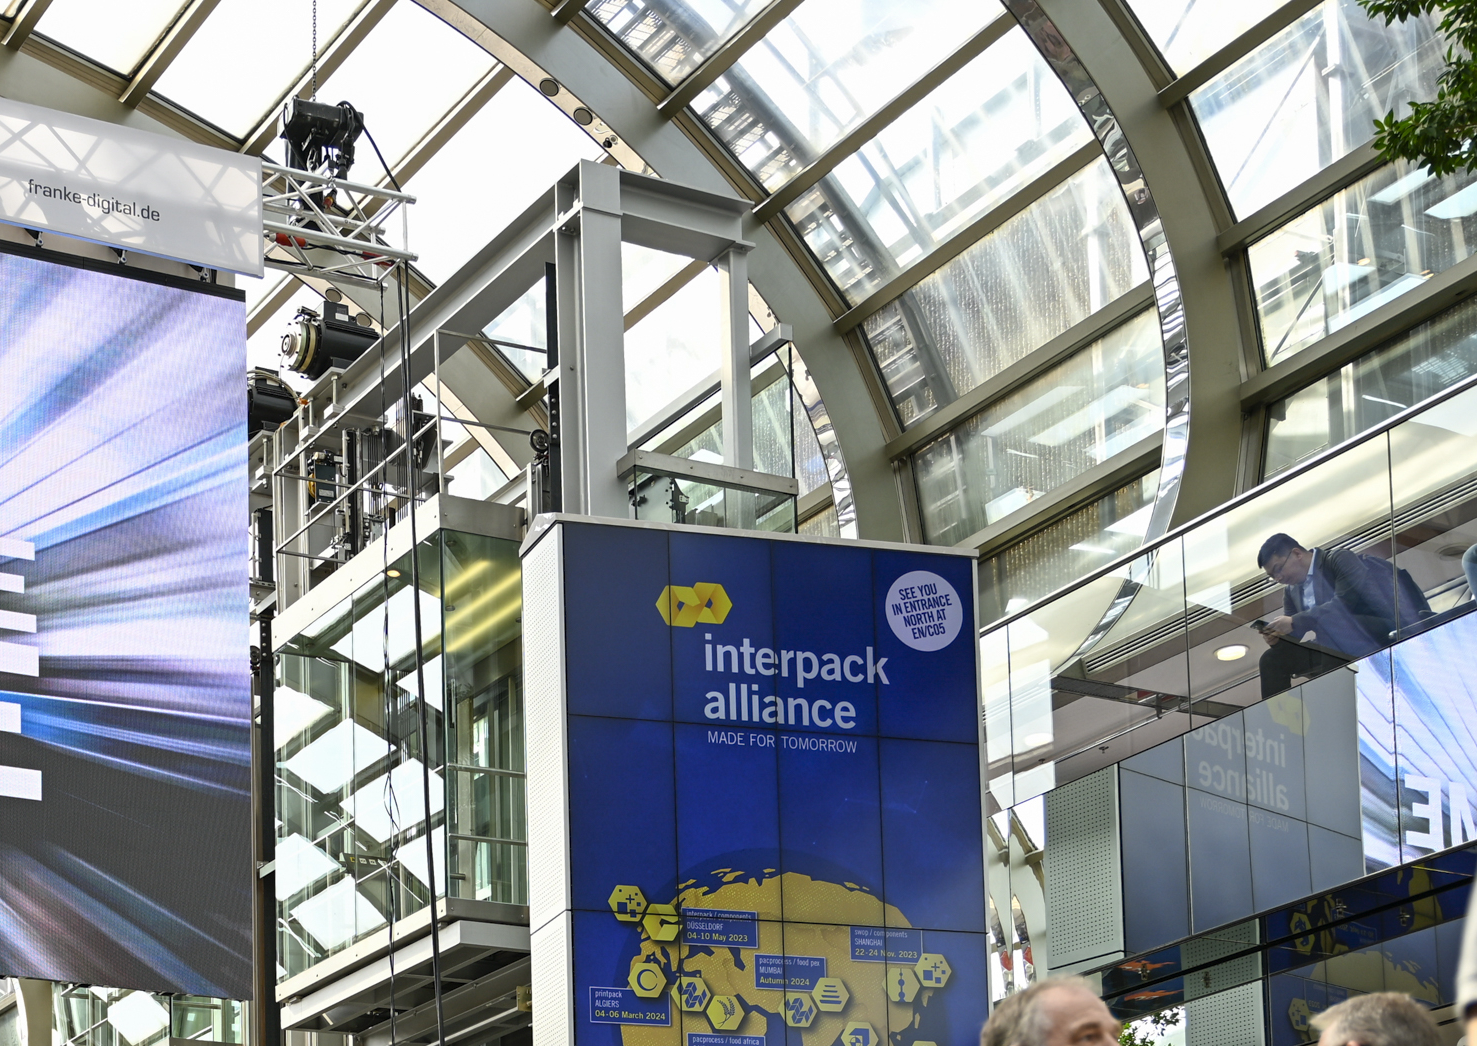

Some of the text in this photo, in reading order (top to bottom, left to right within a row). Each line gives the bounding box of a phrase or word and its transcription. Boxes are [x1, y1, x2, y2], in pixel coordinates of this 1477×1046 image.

[28, 178, 161, 223] franke-digital.de
[899, 583, 937, 601] SEE YOU
[892, 594, 952, 616] IN ENTRANCE
[903, 608, 946, 627] NORTH AT
[705, 633, 890, 688] interpack
[704, 683, 856, 729] alliance
[707, 731, 857, 754] MADE FOR TOMORROW
[686, 921, 723, 930] DÜSSELDORF
[687, 932, 748, 942] 04-10 May 2023
[873, 931, 908, 939] components
[855, 938, 883, 946] SHANGHAI
[855, 948, 878, 956] 22-24
[899, 950, 918, 958] 2023
[759, 957, 792, 965] pacprocess
[791, 977, 810, 985] 2024
[595, 990, 622, 998] printpack
[595, 1000, 620, 1008] ALGIERS
[622, 1011, 644, 1019] March
[692, 1036, 724, 1044] pacprocess
[729, 1037, 742, 1045] food
[743, 1038, 760, 1046] africa
